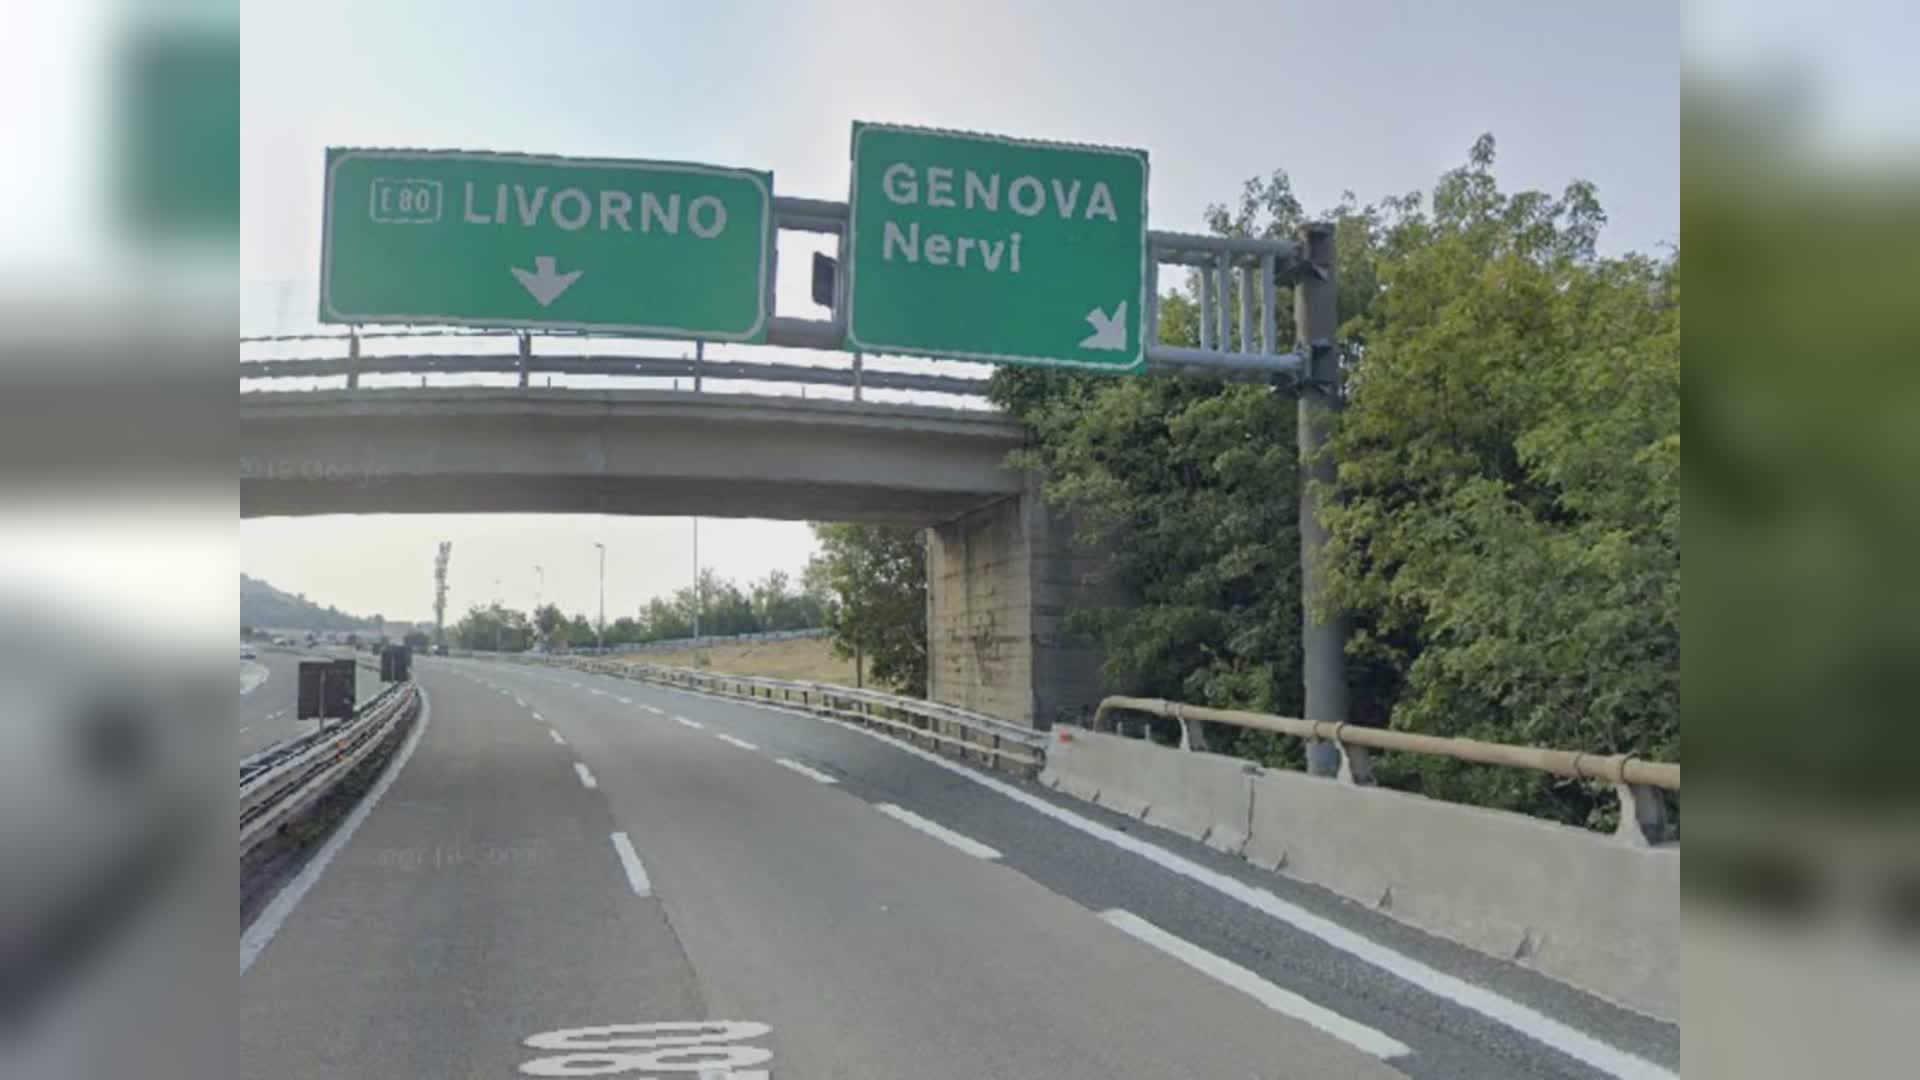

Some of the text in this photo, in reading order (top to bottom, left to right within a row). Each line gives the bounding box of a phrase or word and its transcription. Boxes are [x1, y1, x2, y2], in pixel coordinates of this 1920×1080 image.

[463, 181, 727, 239] LIVORNO
[882, 162, 1118, 222] GENOVA
[882, 220, 1022, 272] Nervi
